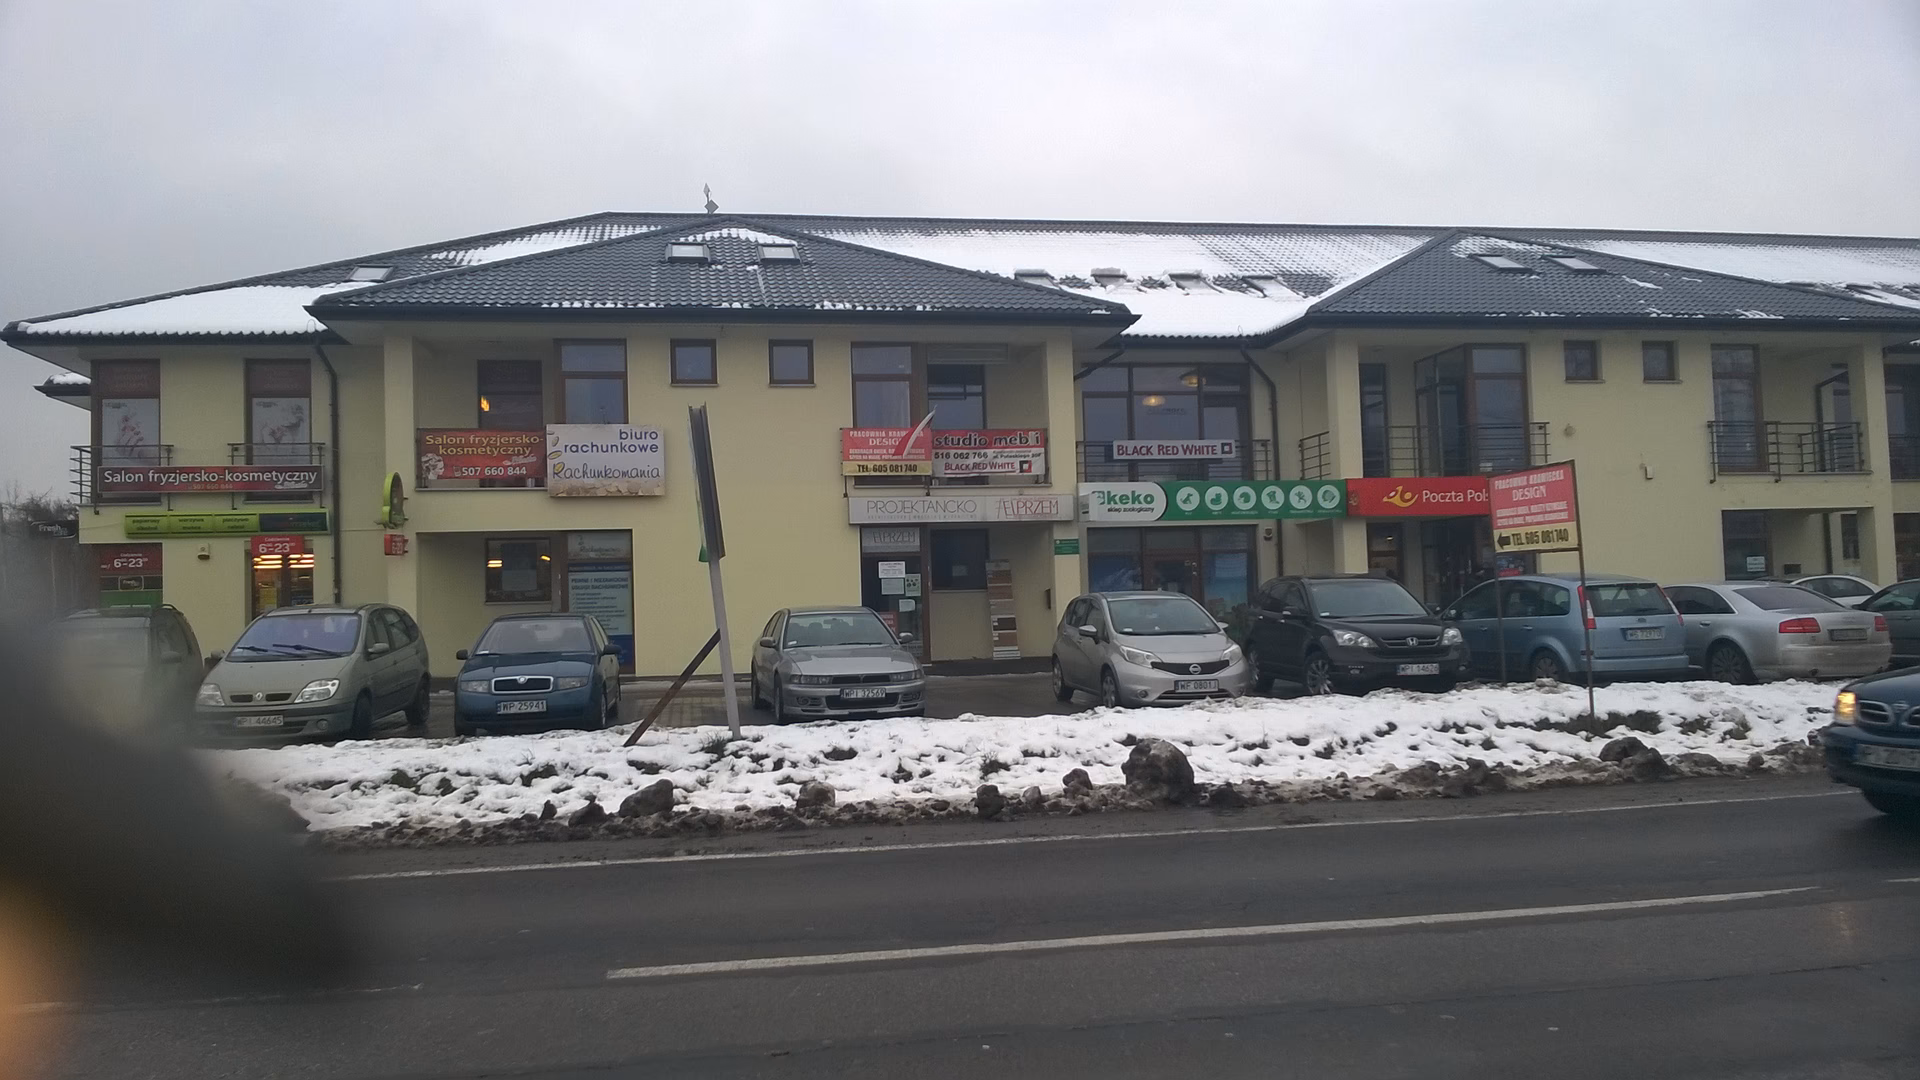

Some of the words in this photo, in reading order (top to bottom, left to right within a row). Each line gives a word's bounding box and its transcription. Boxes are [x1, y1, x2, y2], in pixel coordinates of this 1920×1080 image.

[619, 428, 659, 441] biuro
[849, 430, 886, 438] PRACOWNIA
[934, 433, 988, 447] studio
[425, 435, 465, 445] Salon
[469, 434, 544, 447] fryzjersko-
[869, 437, 902, 446] DESIG
[439, 445, 532, 457] kosmetyczny
[564, 441, 659, 454] rachunkowe
[1116, 444, 1153, 456] BLACK
[1157, 444, 1179, 456] RED
[1181, 444, 1218, 456] WHITE
[934, 451, 951, 459] 516
[953, 452, 969, 460] 062
[972, 451, 988, 460] 766
[462, 466, 481, 476] 507
[484, 466, 505, 476] 660
[507, 466, 527, 476] 844
[552, 462, 661, 480] Rachunkomania
[872, 463, 888, 473] 605
[944, 462, 971, 471] BLACK
[972, 461, 988, 471] RED
[989, 460, 1016, 471] WHITE
[104, 470, 144, 483] Salon
[148, 470, 317, 485] fryzjersko-kosmetyczny
[1106, 490, 1154, 505] keko
[1422, 490, 1464, 503] Poczta
[1512, 485, 1547, 501] DESIGN
[867, 500, 977, 514] PROJEKTANCKO
[861, 688, 886, 697] 32569
[502, 703, 515, 711] WP
[518, 701, 545, 711] 25941
